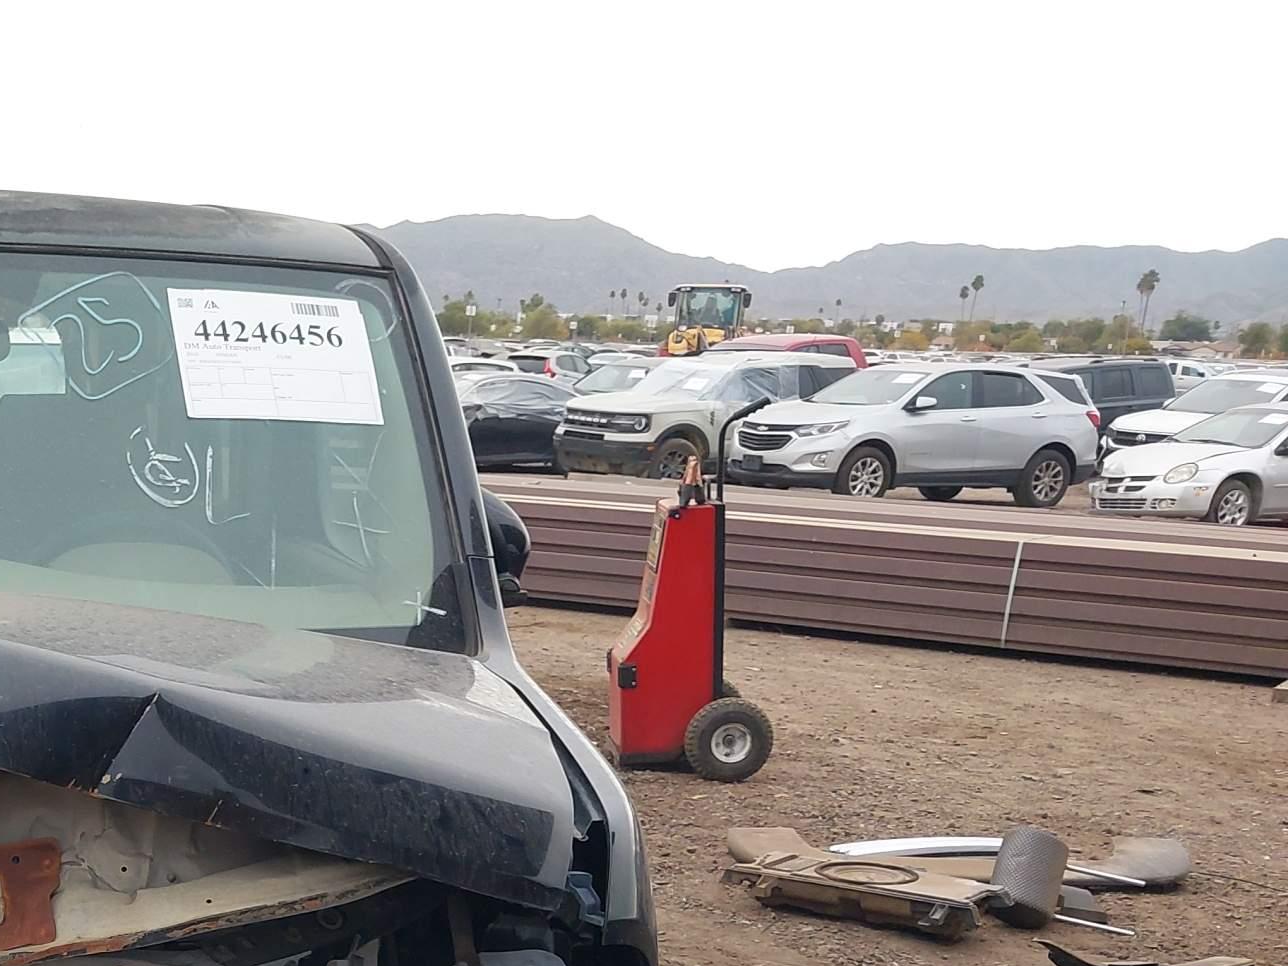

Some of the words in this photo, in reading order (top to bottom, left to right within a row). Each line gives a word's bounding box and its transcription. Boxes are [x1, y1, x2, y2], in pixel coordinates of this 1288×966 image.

[193, 319, 344, 348] 44246456
[183, 342, 200, 350] DM
[202, 342, 223, 350] Auto
[224, 343, 262, 352] Transport
